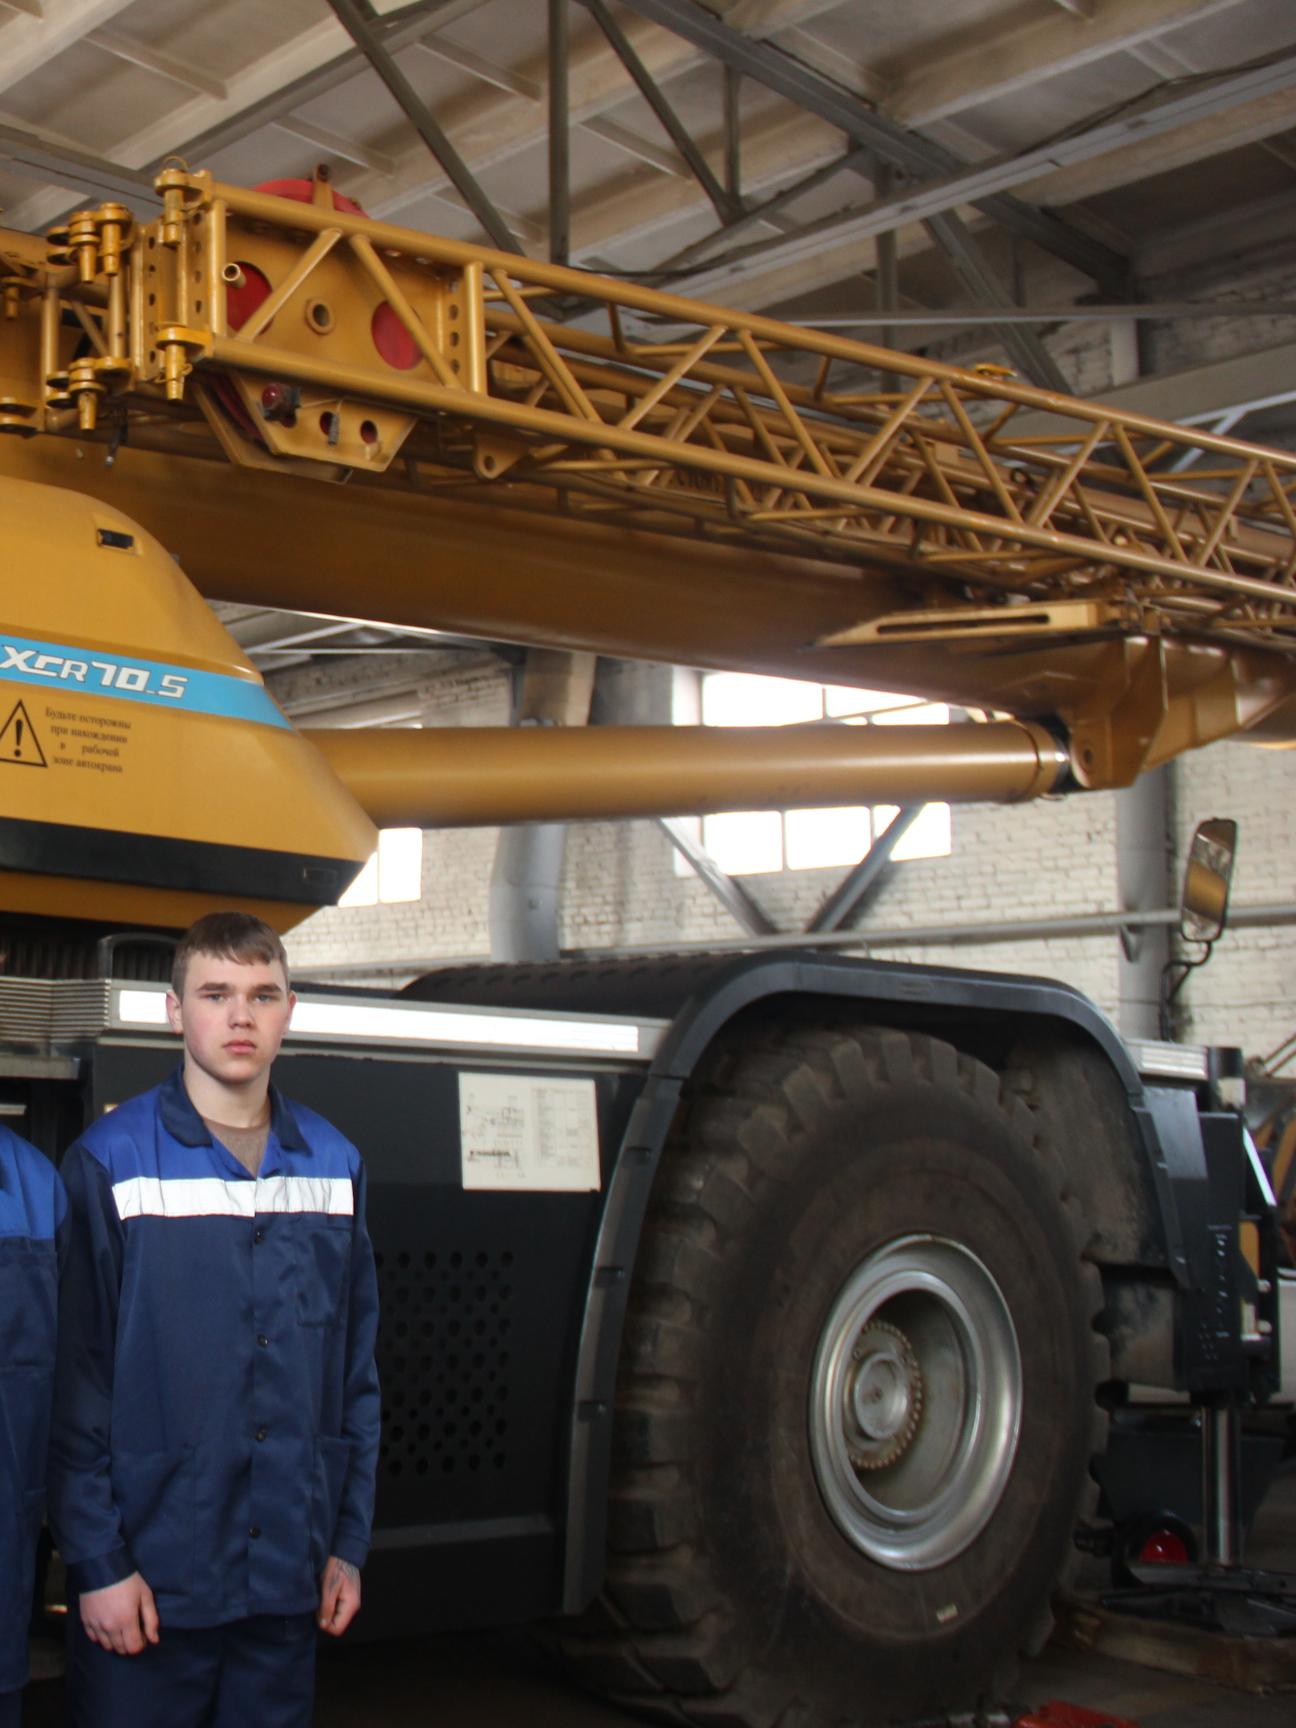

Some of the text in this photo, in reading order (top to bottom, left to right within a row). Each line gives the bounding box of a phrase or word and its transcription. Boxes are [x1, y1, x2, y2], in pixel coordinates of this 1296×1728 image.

[45, 706, 132, 730] Будьте осторожны
[50, 725, 69, 736] при
[81, 744, 120, 758] рабочей
[53, 756, 123, 774] зоне автокрана
